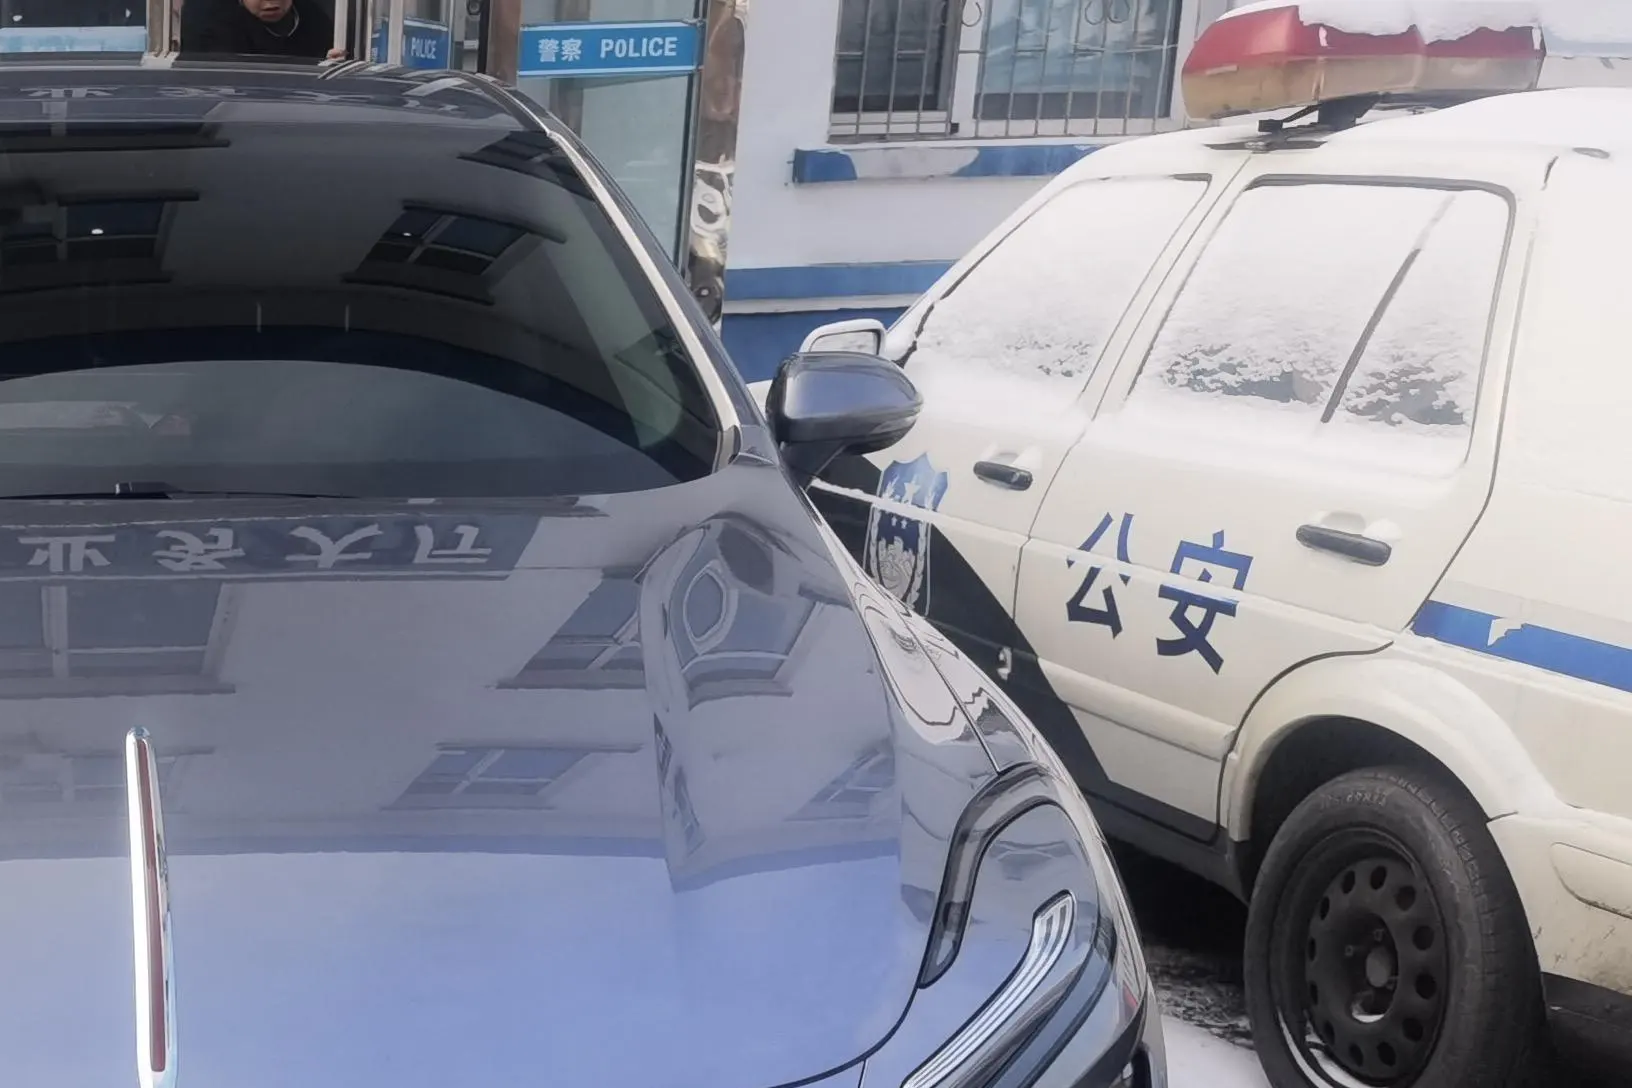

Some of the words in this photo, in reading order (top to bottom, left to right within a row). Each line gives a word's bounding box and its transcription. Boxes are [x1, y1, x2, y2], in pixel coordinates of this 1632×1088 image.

[538, 38, 582, 62] 警察
[600, 37, 678, 58] POLICE
[1066, 512, 1254, 675] 公安
